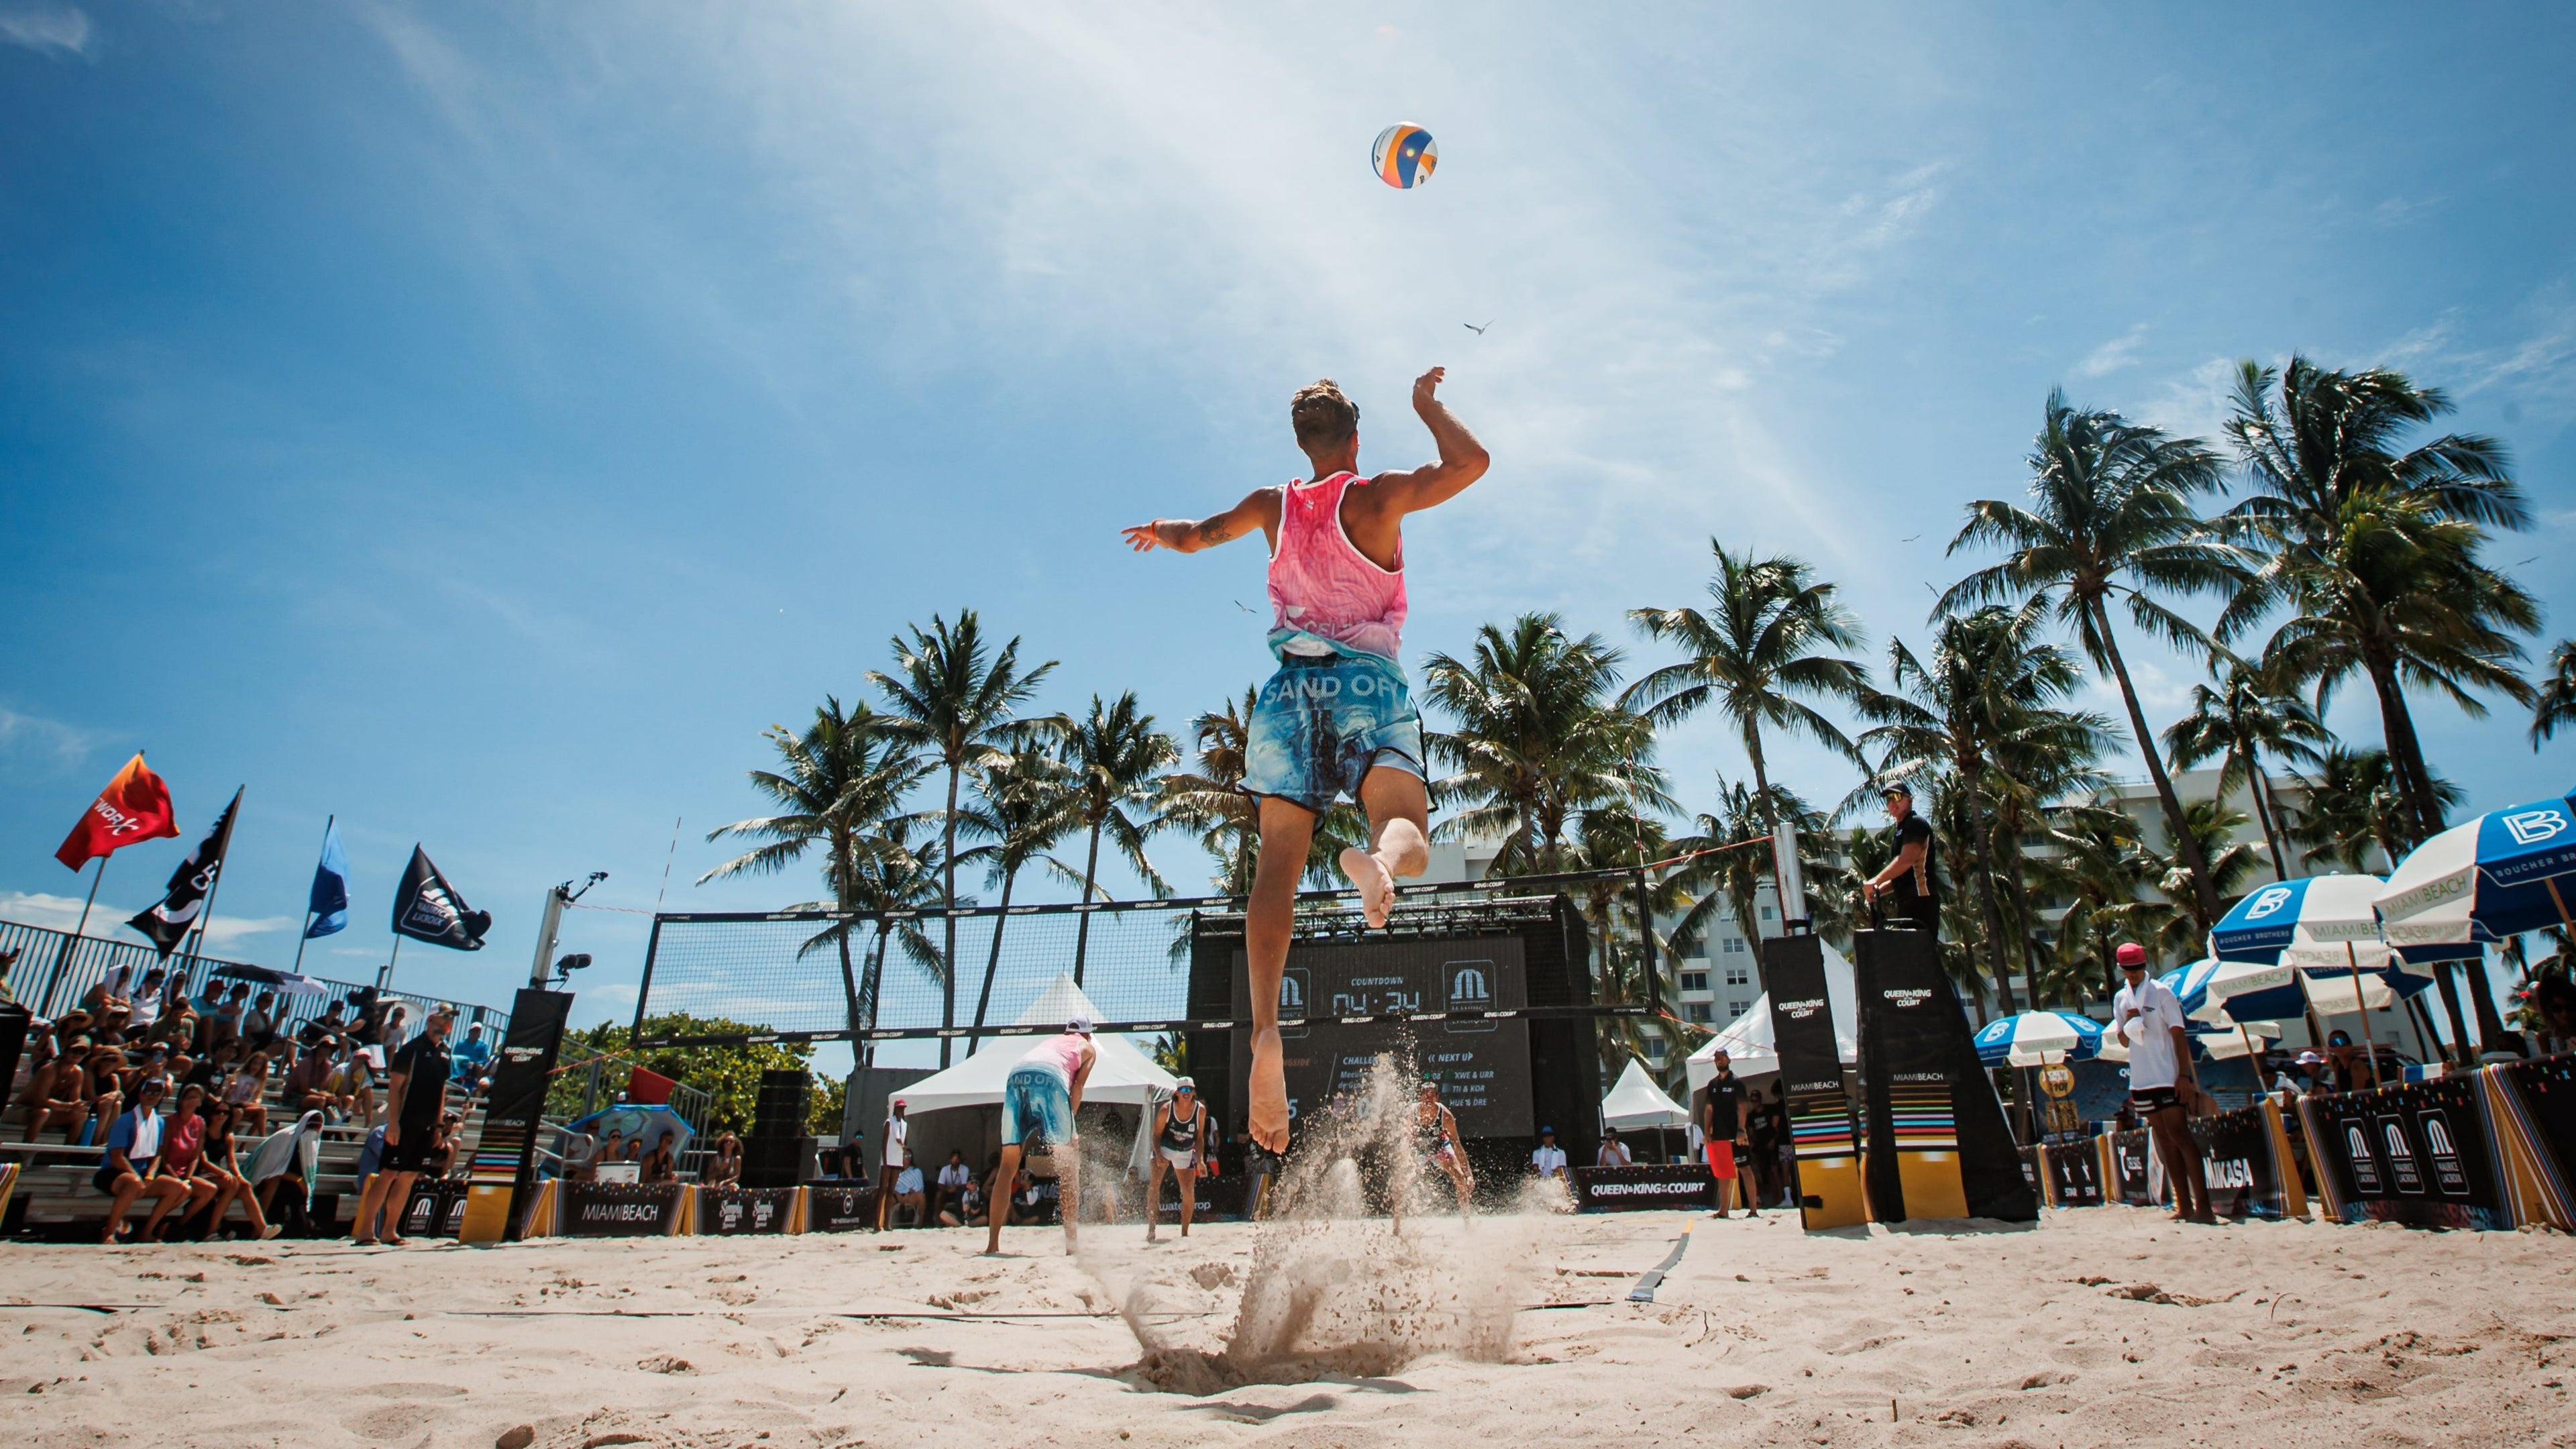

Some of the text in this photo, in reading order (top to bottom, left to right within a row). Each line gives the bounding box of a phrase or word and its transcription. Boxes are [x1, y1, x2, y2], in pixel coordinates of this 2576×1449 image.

[1264, 676, 1342, 704] SAND
[2495, 857, 2555, 877] BOUCHER
[2385, 876, 2467, 917] MIAMIBEACH
[2219, 930, 2290, 945] BOUCHER BROTHERS
[1351, 977, 1404, 987] COUNTDOWN
[2218, 971, 2288, 994] MIAMIBEACH
[1791, 1010, 1814, 1018] COURT
[1438, 1052, 1474, 1062] NEXT UP
[1791, 1081, 1839, 1091] MIAMIBEACH
[1473, 1098, 1487, 1106] DRE
[2202, 1157, 2254, 1189] MIKASA
[1668, 1183, 1705, 1193] COURT
[582, 1204, 659, 1221] MIAMIBEACH
[1159, 1200, 1212, 1212] waterop
